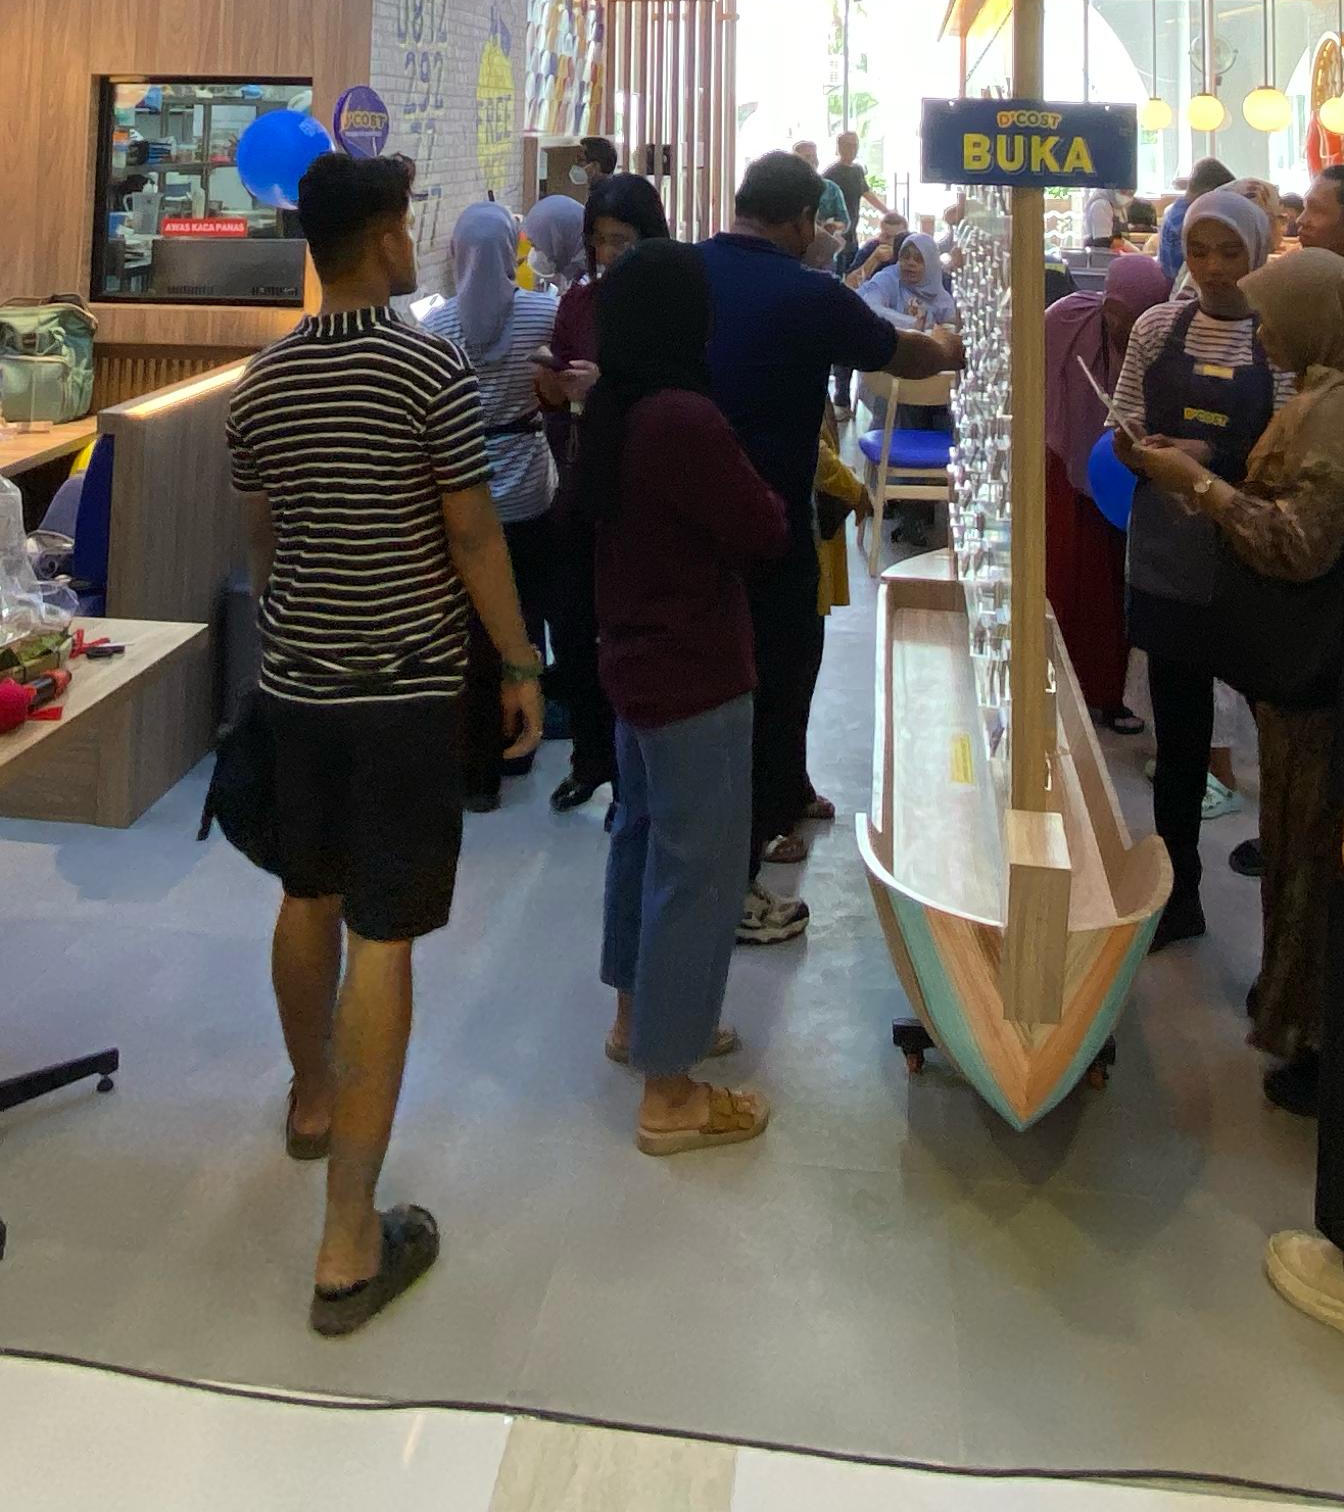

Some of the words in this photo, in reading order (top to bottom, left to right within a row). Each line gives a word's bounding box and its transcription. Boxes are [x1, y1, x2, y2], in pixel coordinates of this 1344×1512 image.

[997, 110, 1062, 129] D'COST
[962, 132, 1096, 174] BUKA
[164, 222, 190, 232] AWAS
[191, 222, 215, 232] KACA
